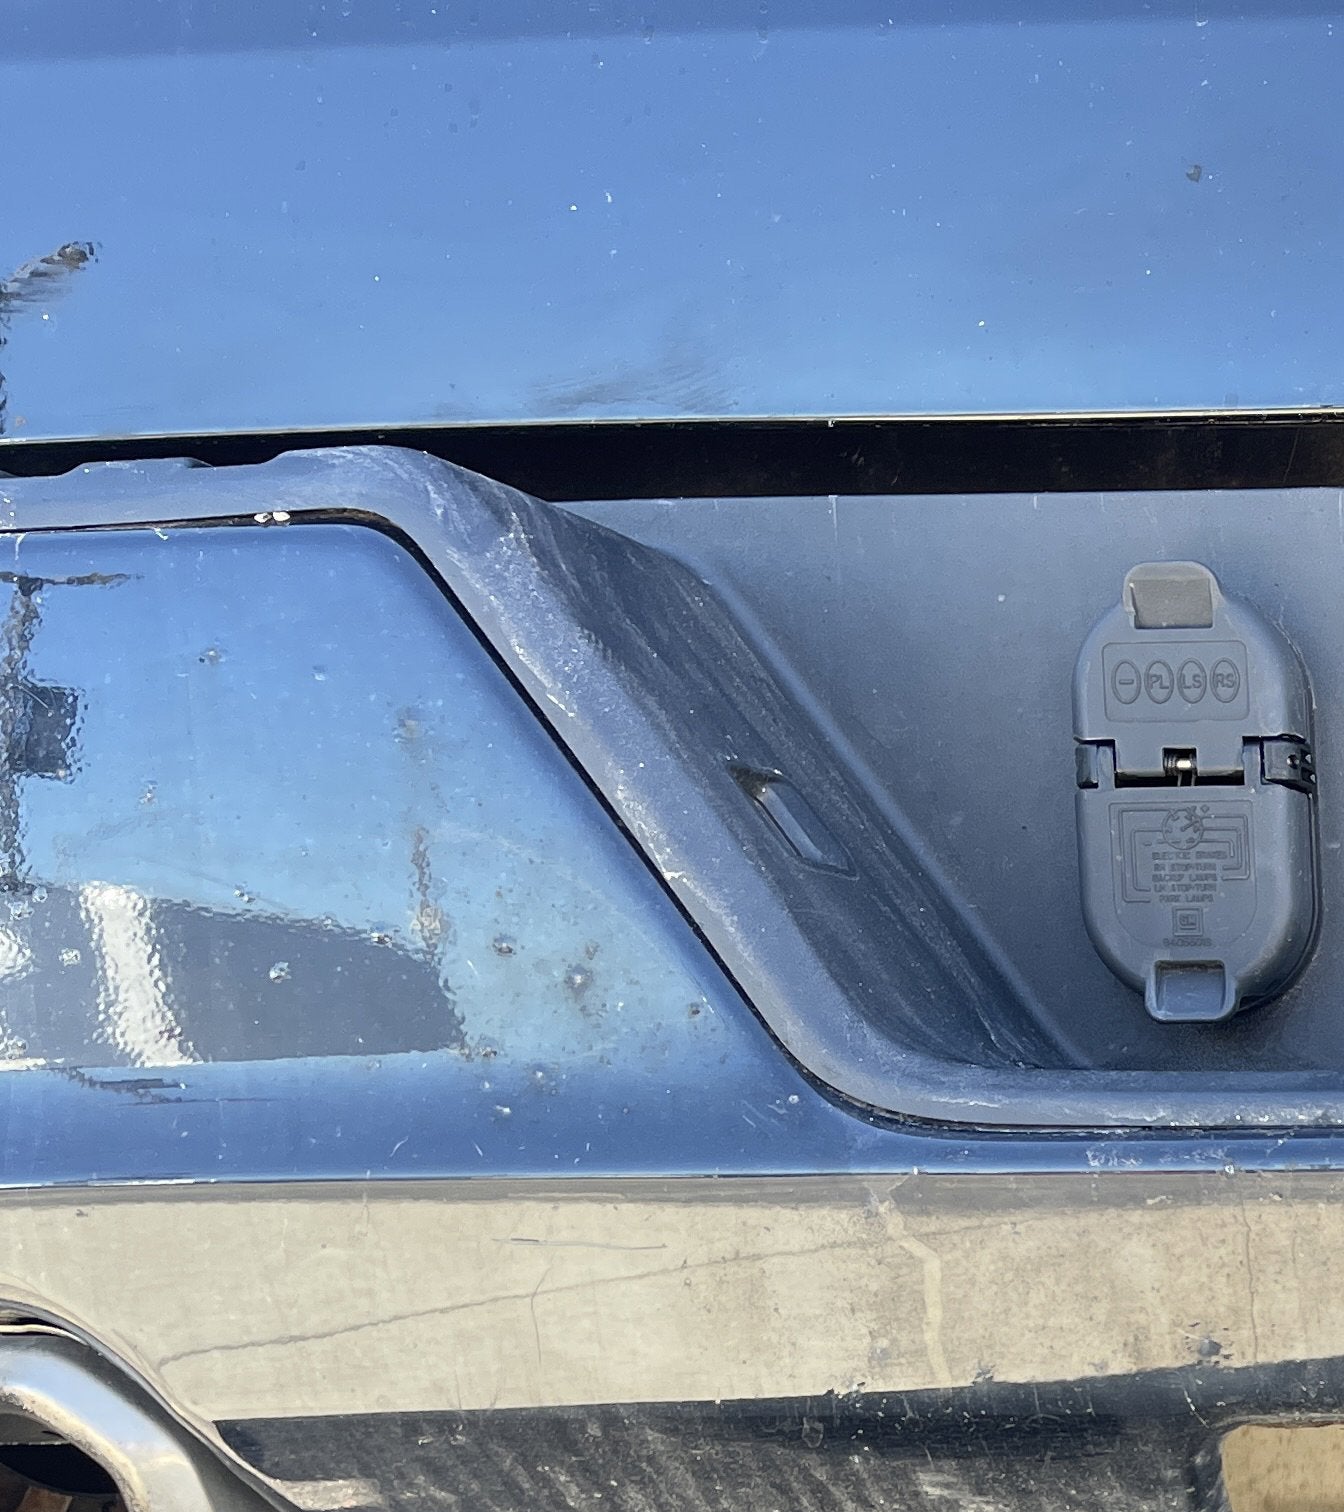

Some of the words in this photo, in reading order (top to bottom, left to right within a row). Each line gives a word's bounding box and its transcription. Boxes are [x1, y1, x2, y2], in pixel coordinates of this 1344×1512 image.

[1150, 673, 1169, 689] PL
[1182, 673, 1202, 689] LS
[1215, 672, 1236, 688] RS
